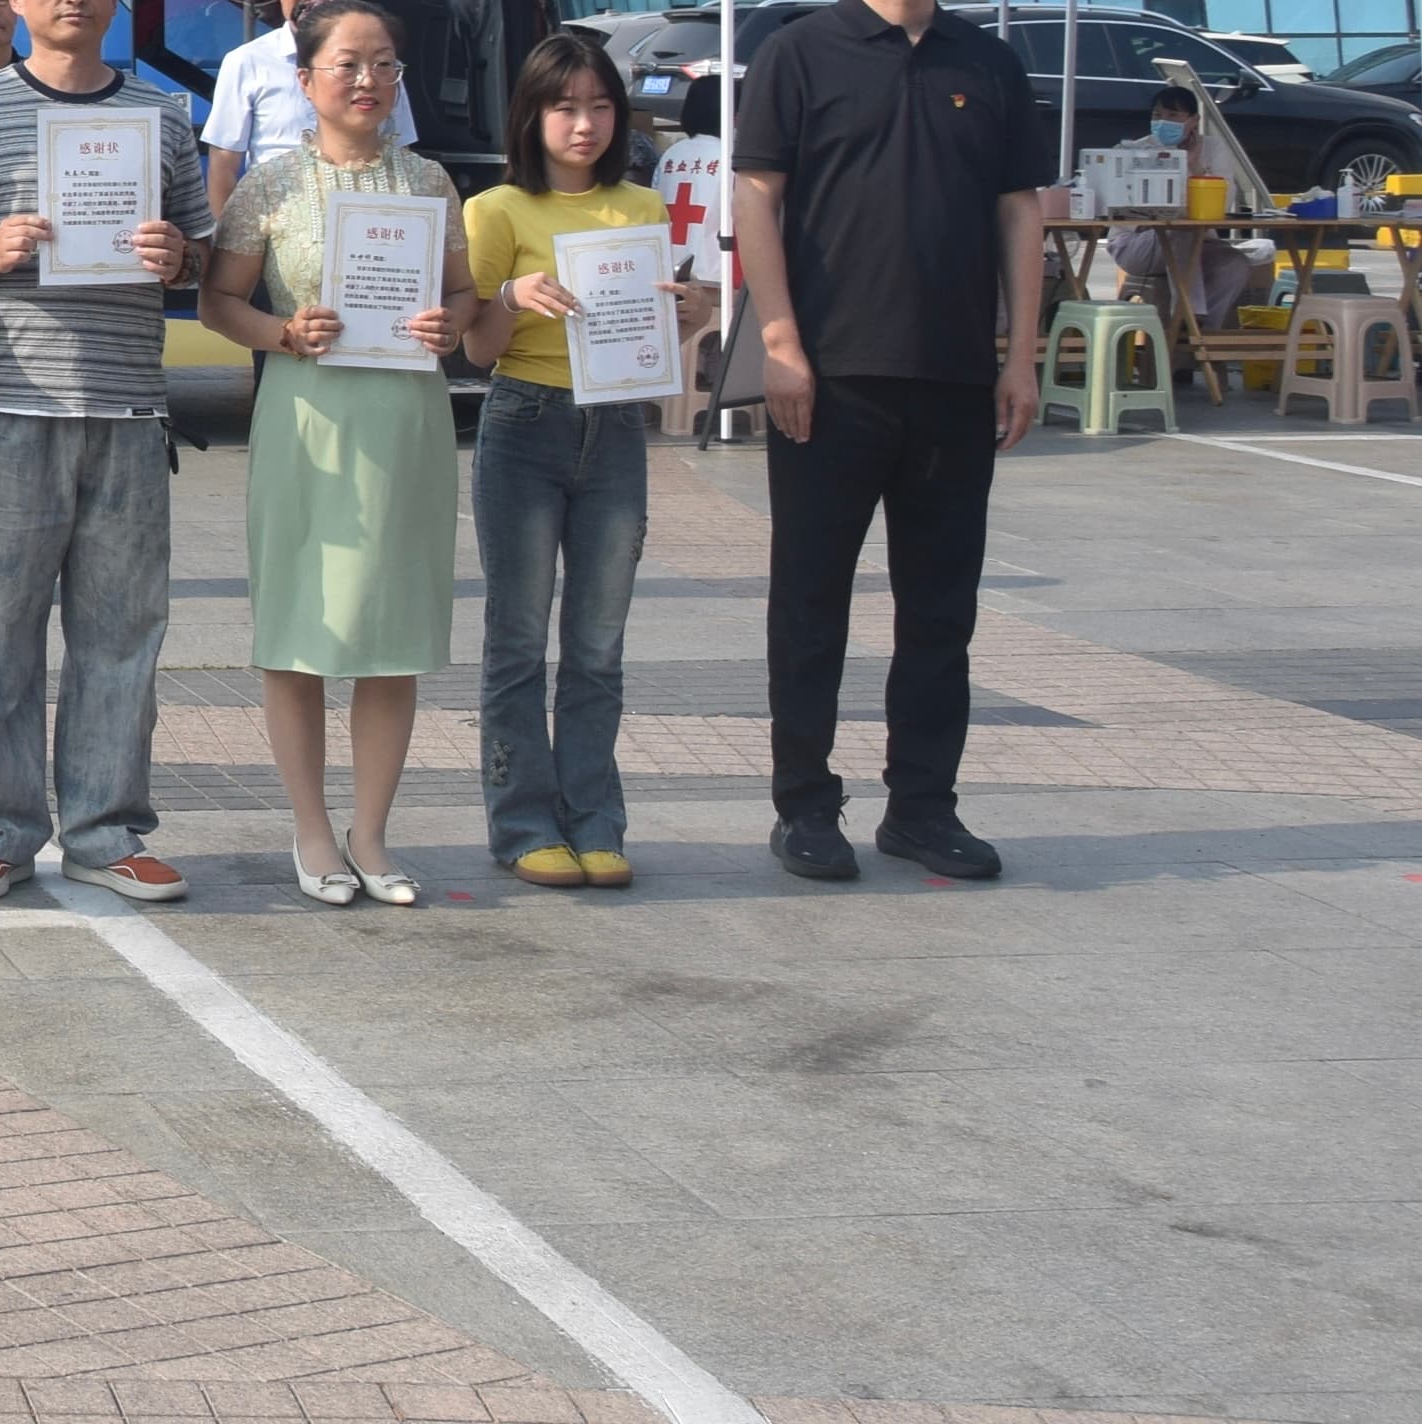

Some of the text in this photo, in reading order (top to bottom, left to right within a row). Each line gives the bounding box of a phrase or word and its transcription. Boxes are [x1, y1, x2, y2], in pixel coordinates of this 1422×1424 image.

[79, 141, 120, 155] 感谢状
[366, 227, 406, 241] 感谢状
[597, 260, 637, 275] 感谢状
